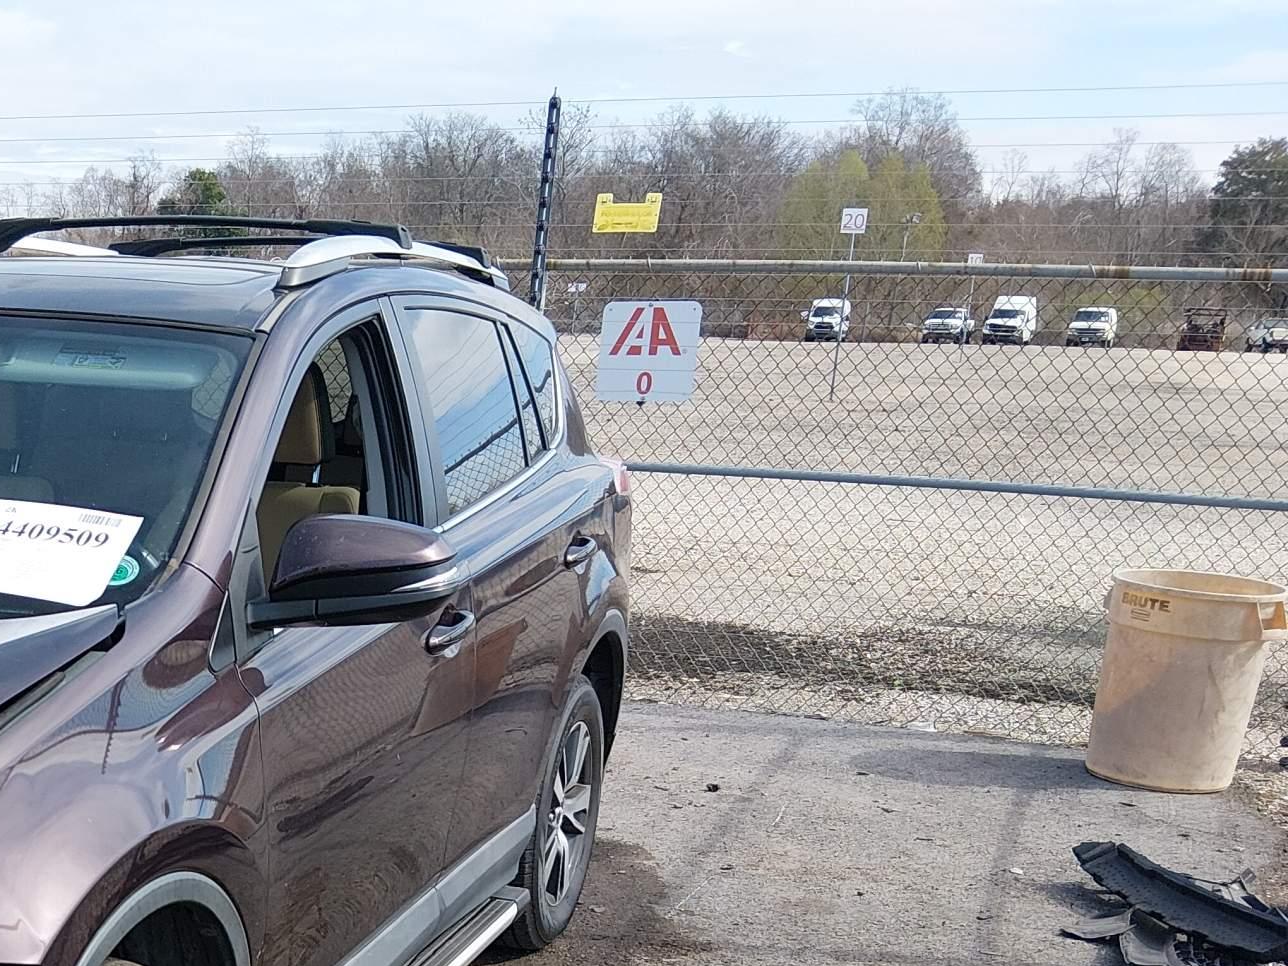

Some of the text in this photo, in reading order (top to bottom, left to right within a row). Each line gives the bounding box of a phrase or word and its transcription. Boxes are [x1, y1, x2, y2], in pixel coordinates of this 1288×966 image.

[843, 213, 865, 229] 20
[636, 371, 653, 395] 0
[1121, 591, 1171, 613] BRUTE
